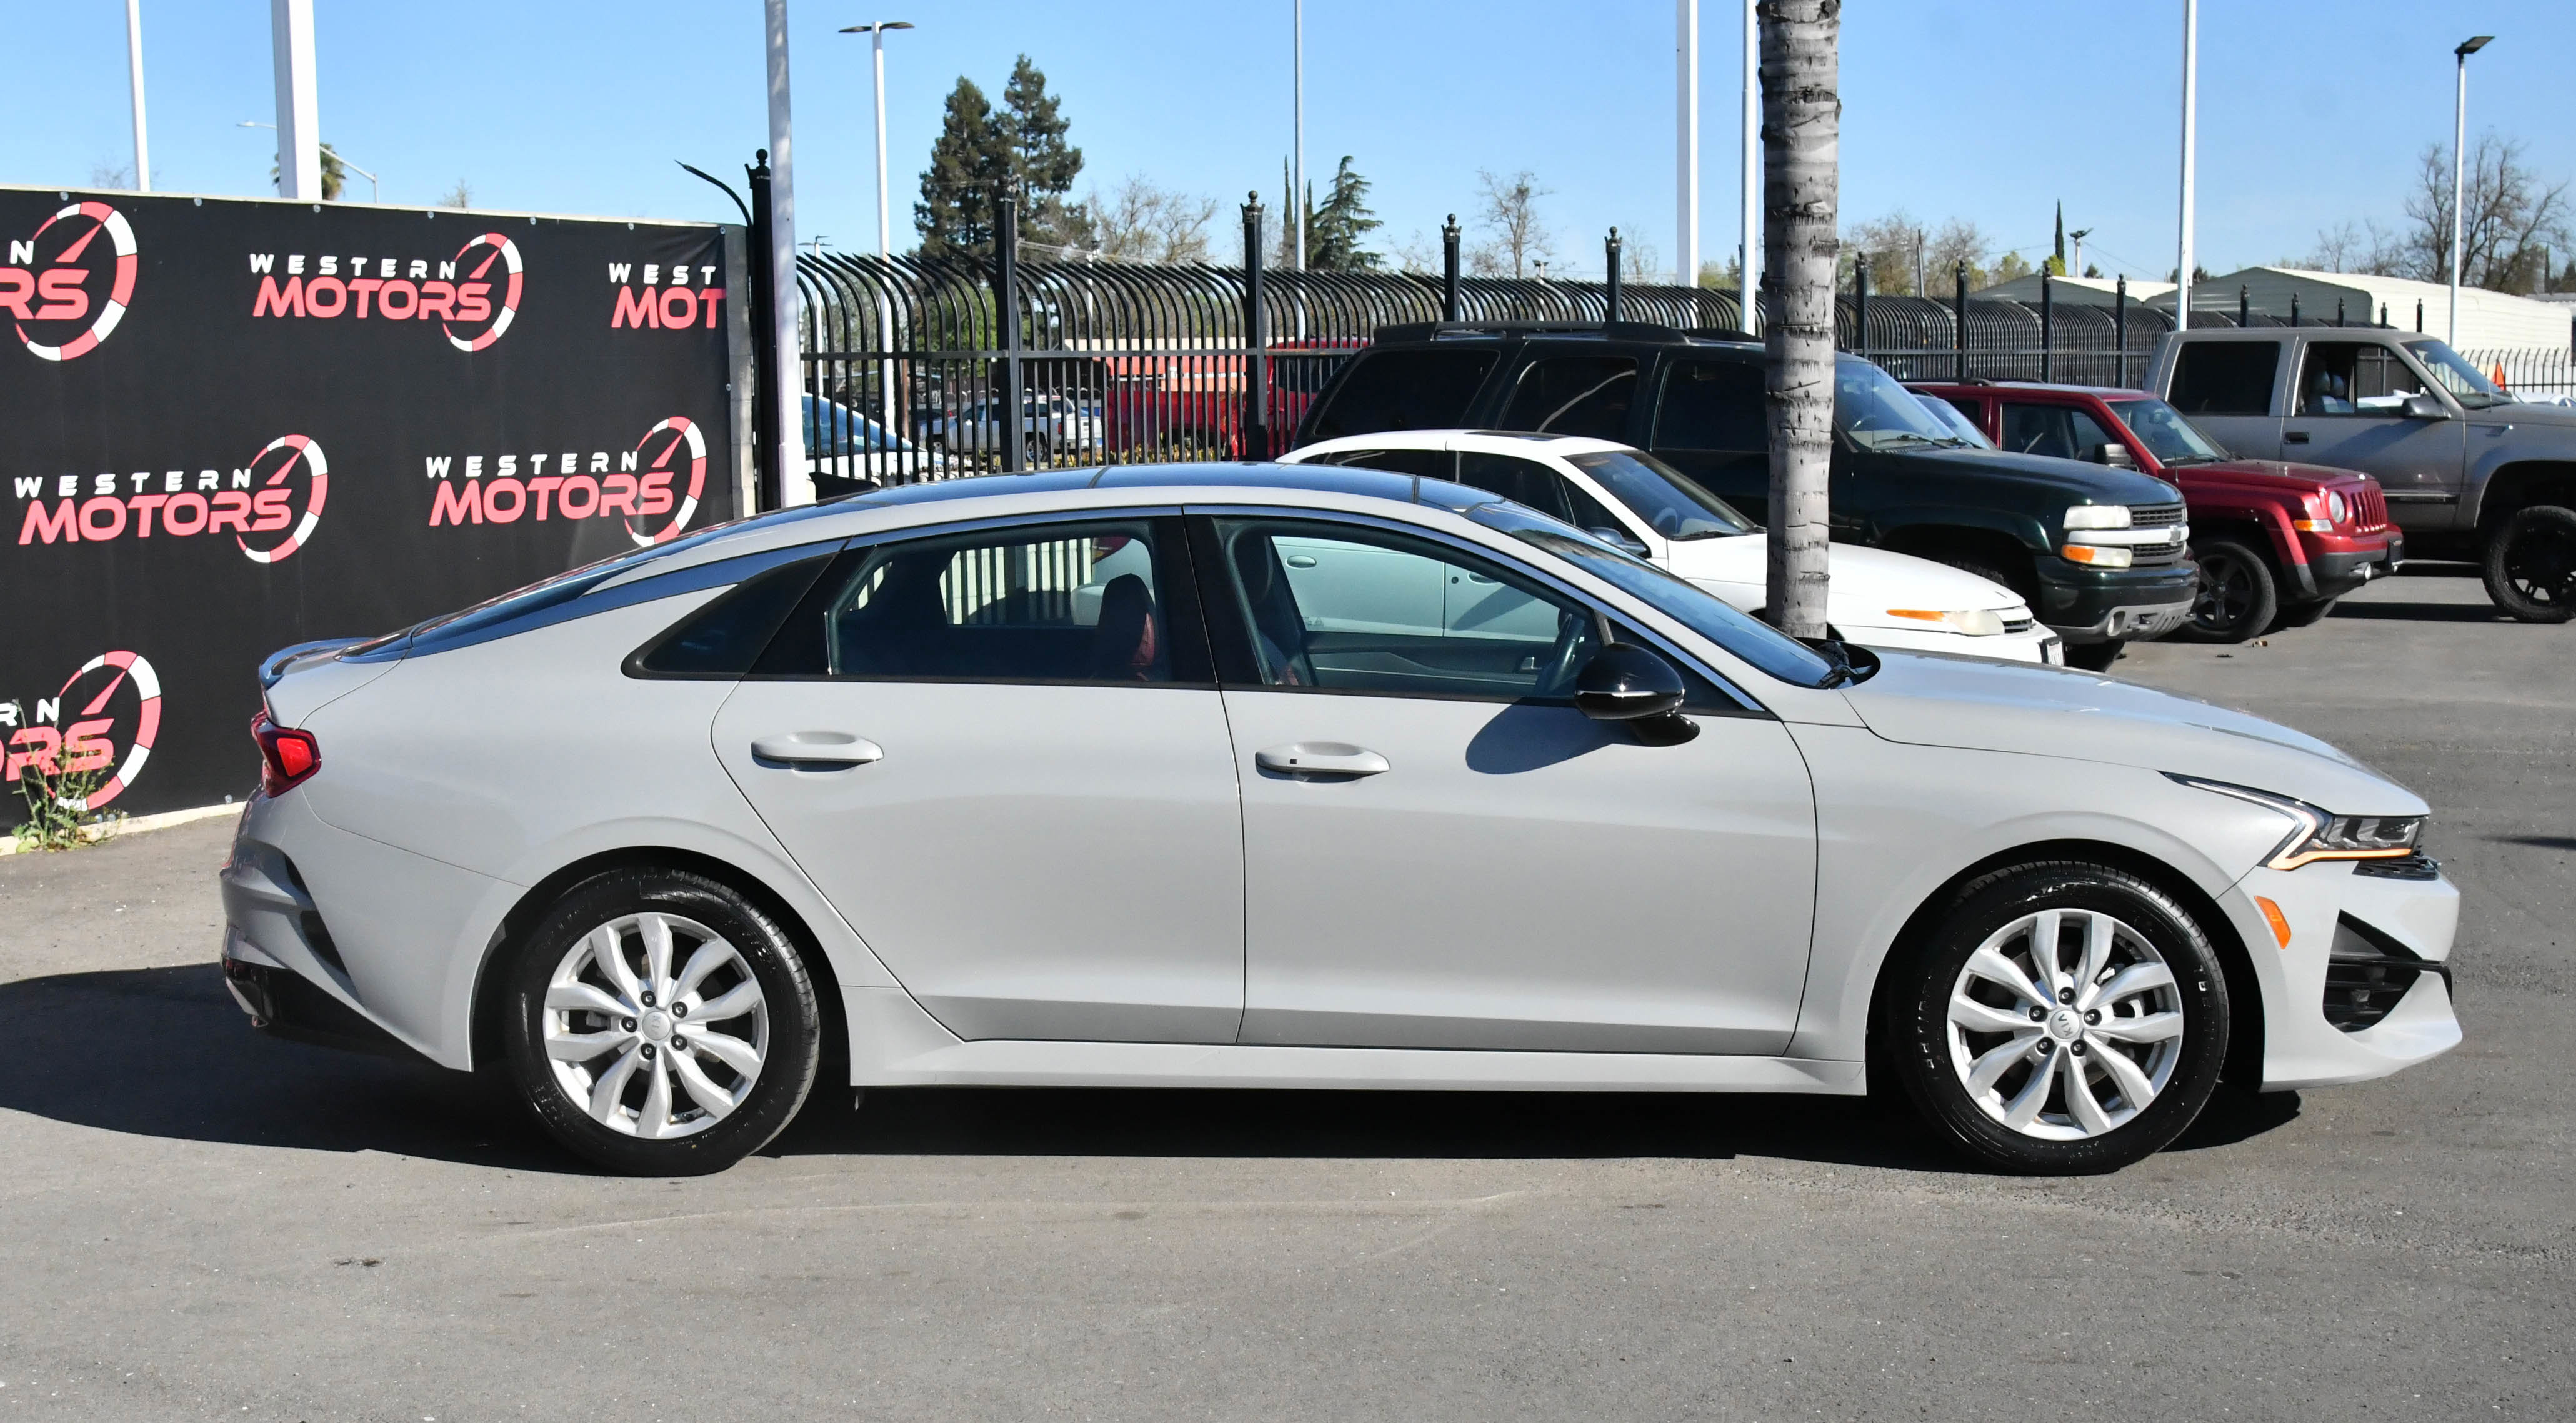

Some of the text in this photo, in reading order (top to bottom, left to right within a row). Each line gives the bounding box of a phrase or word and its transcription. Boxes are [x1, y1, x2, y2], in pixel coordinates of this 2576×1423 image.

[250, 254, 456, 279] WESTERN
[609, 263, 716, 284] WEST
[253, 276, 491, 321] MOTORS
[611, 286, 726, 329] MOT
[15, 468, 251, 498] WESTERN
[426, 451, 637, 479] WESTERN
[19, 489, 291, 545] MOTORS
[429, 472, 674, 526] MOTORS
[0, 718, 114, 781] RS
